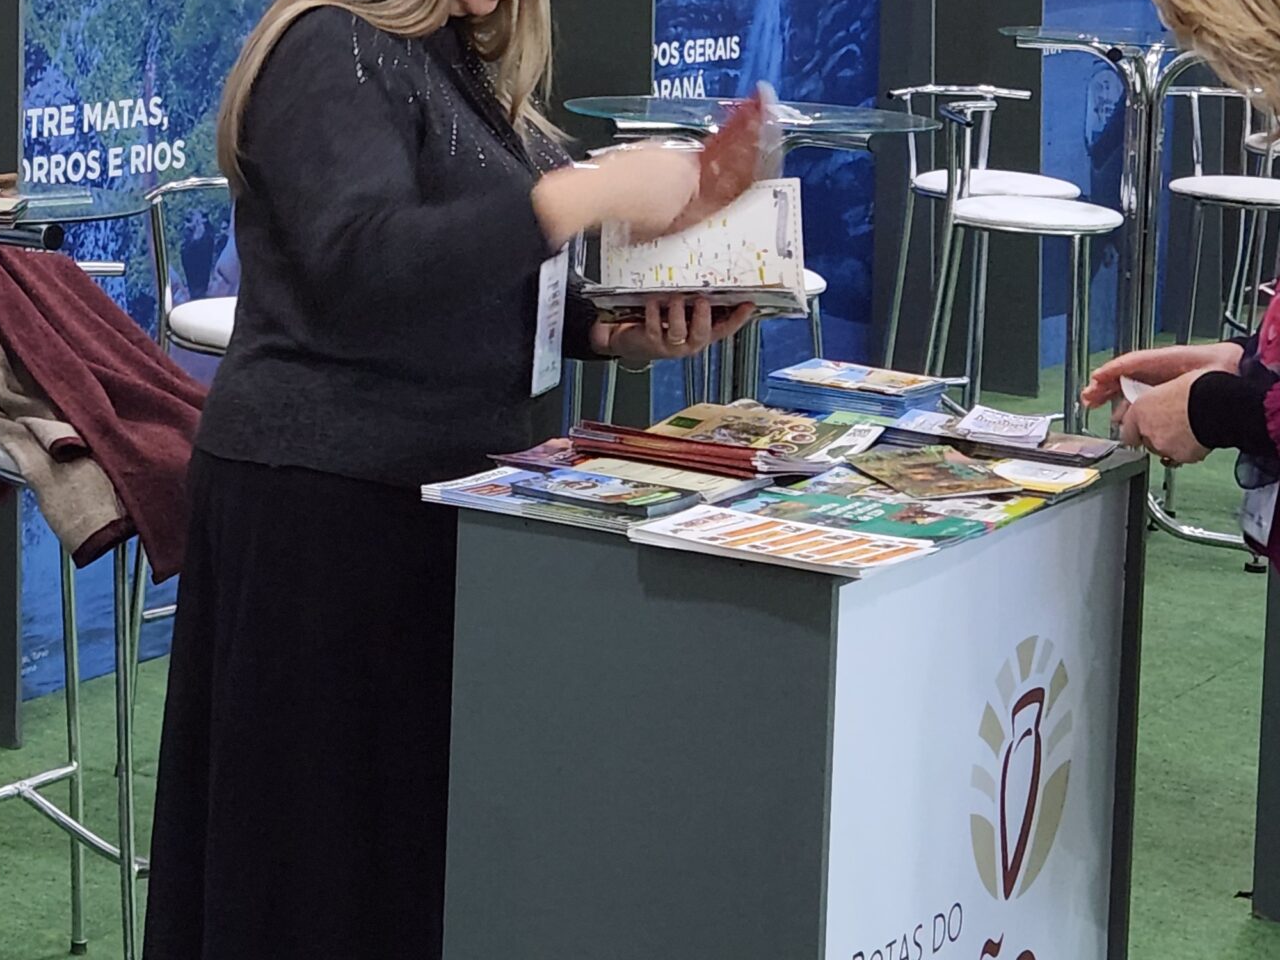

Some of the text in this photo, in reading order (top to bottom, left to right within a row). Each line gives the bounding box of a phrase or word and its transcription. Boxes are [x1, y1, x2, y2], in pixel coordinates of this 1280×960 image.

[684, 36, 740, 64] GERAIS
[23, 96, 169, 139] TRE MATAS,
[108, 147, 123, 177] E
[130, 140, 186, 174] RIOS
[932, 902, 963, 953] DO
